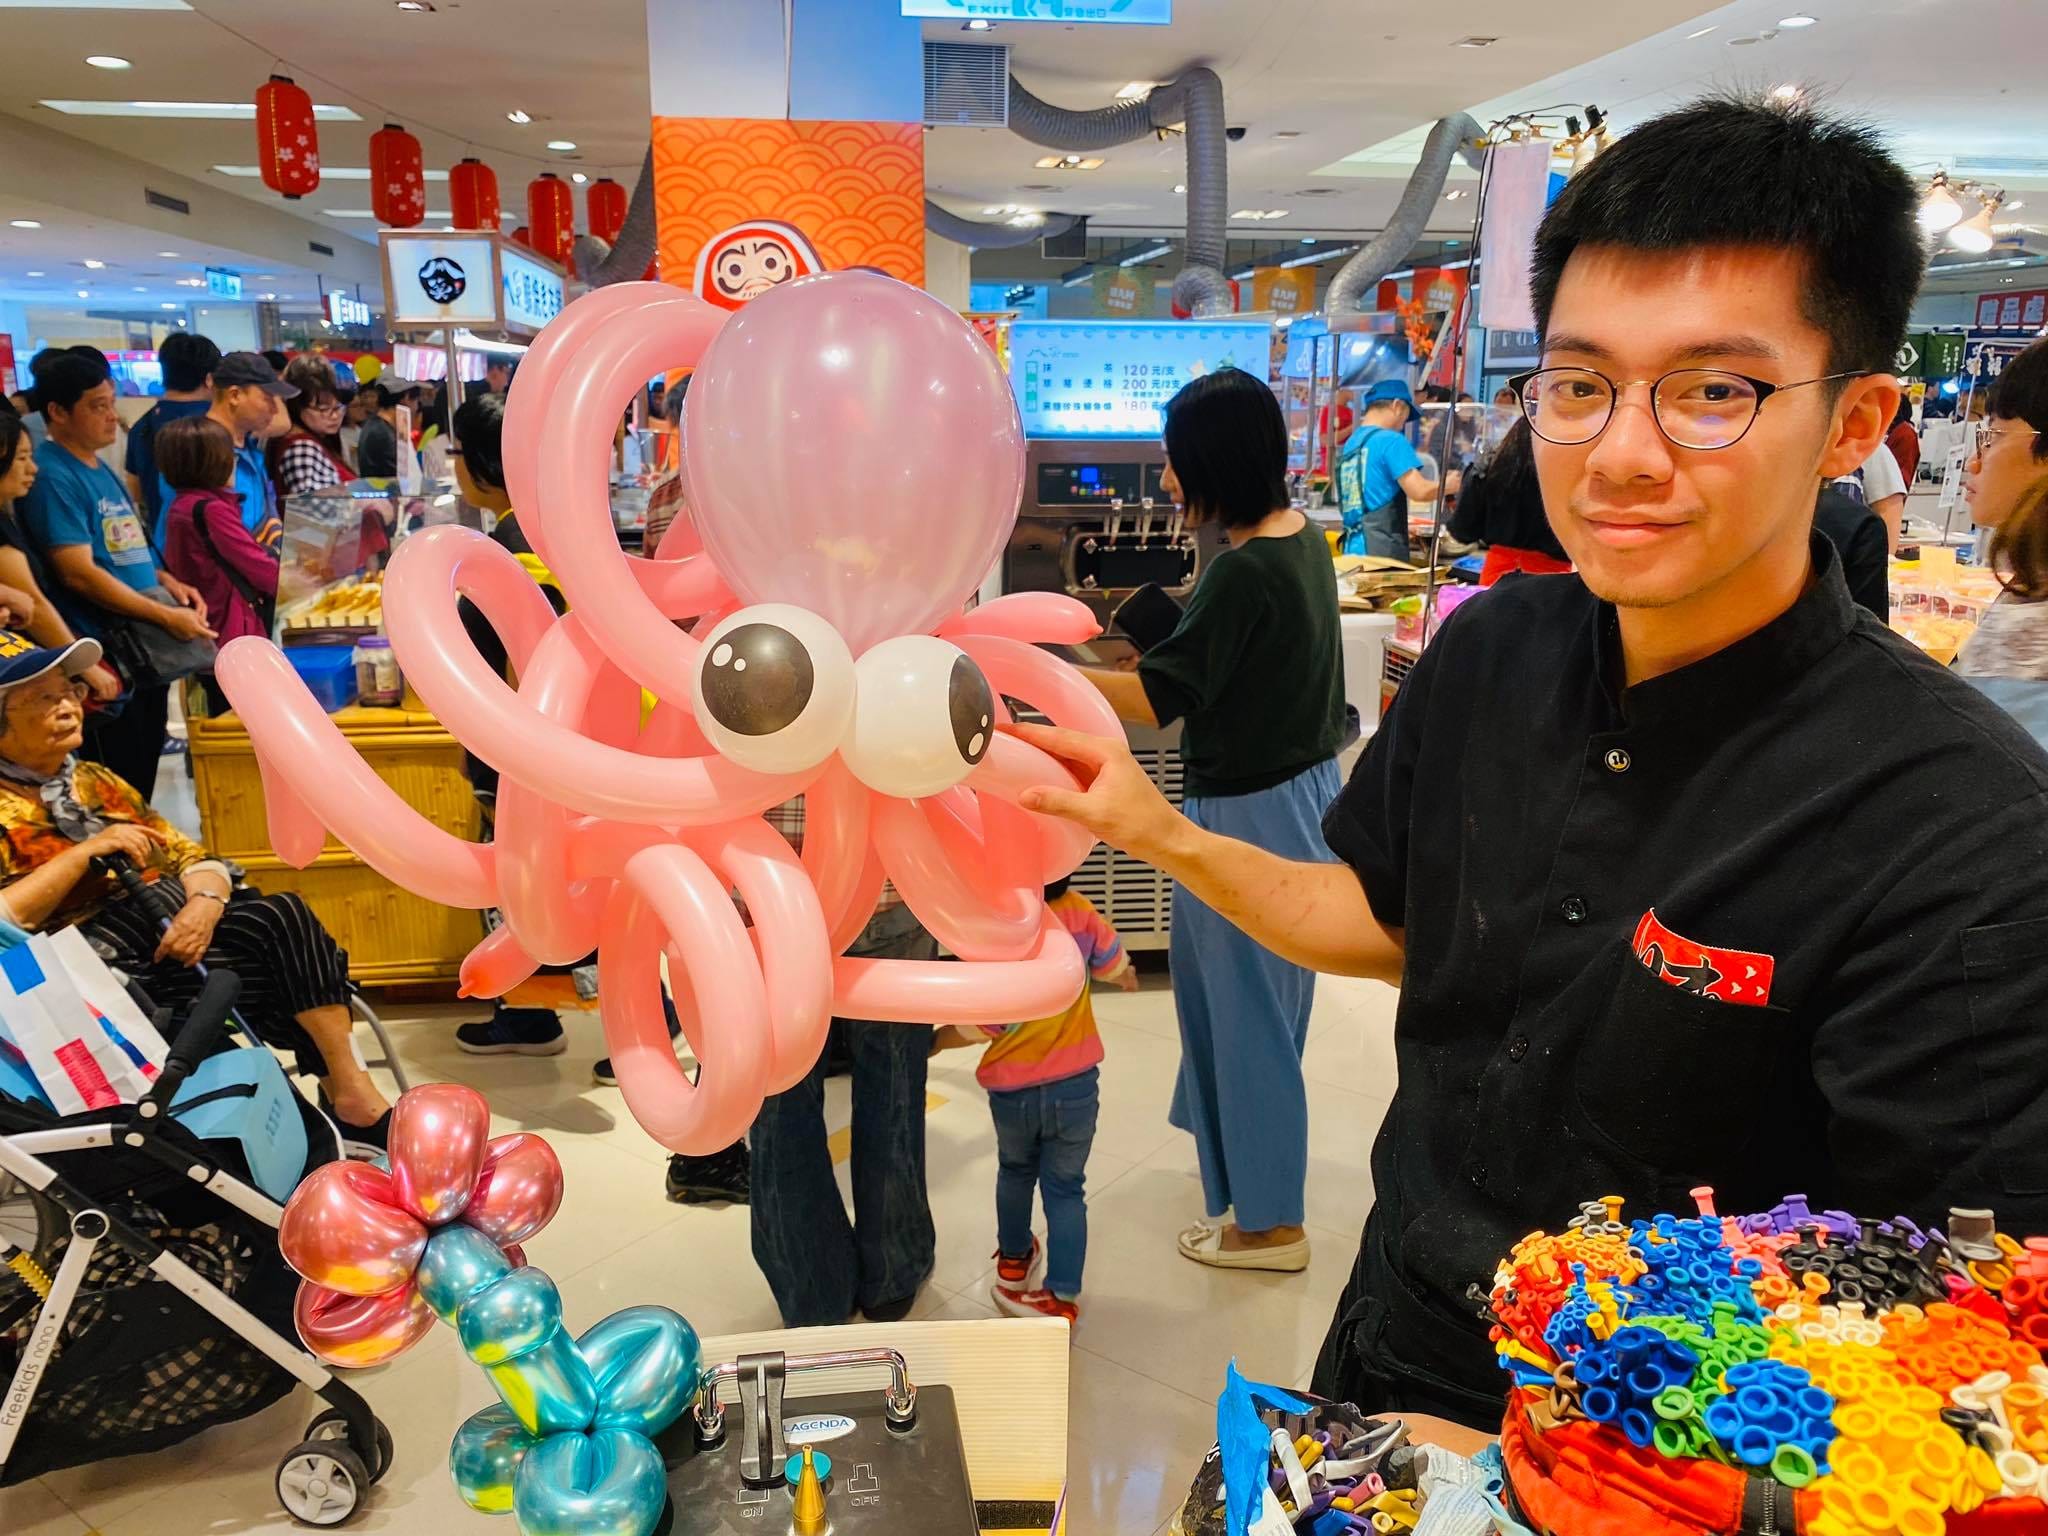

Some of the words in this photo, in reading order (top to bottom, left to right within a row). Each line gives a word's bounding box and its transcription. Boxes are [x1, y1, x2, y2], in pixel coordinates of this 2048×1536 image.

[967, 5, 1009, 14] EXIT
[1123, 364, 1148, 376] 120
[1122, 379, 1148, 390] 200
[1123, 400, 1148, 411] 180
[1, 1363, 40, 1426] Freekids
[33, 1325, 56, 1359] nano
[783, 1419, 849, 1432] LAGENDA
[851, 1495, 880, 1507] OFF
[740, 1506, 764, 1518] ON
